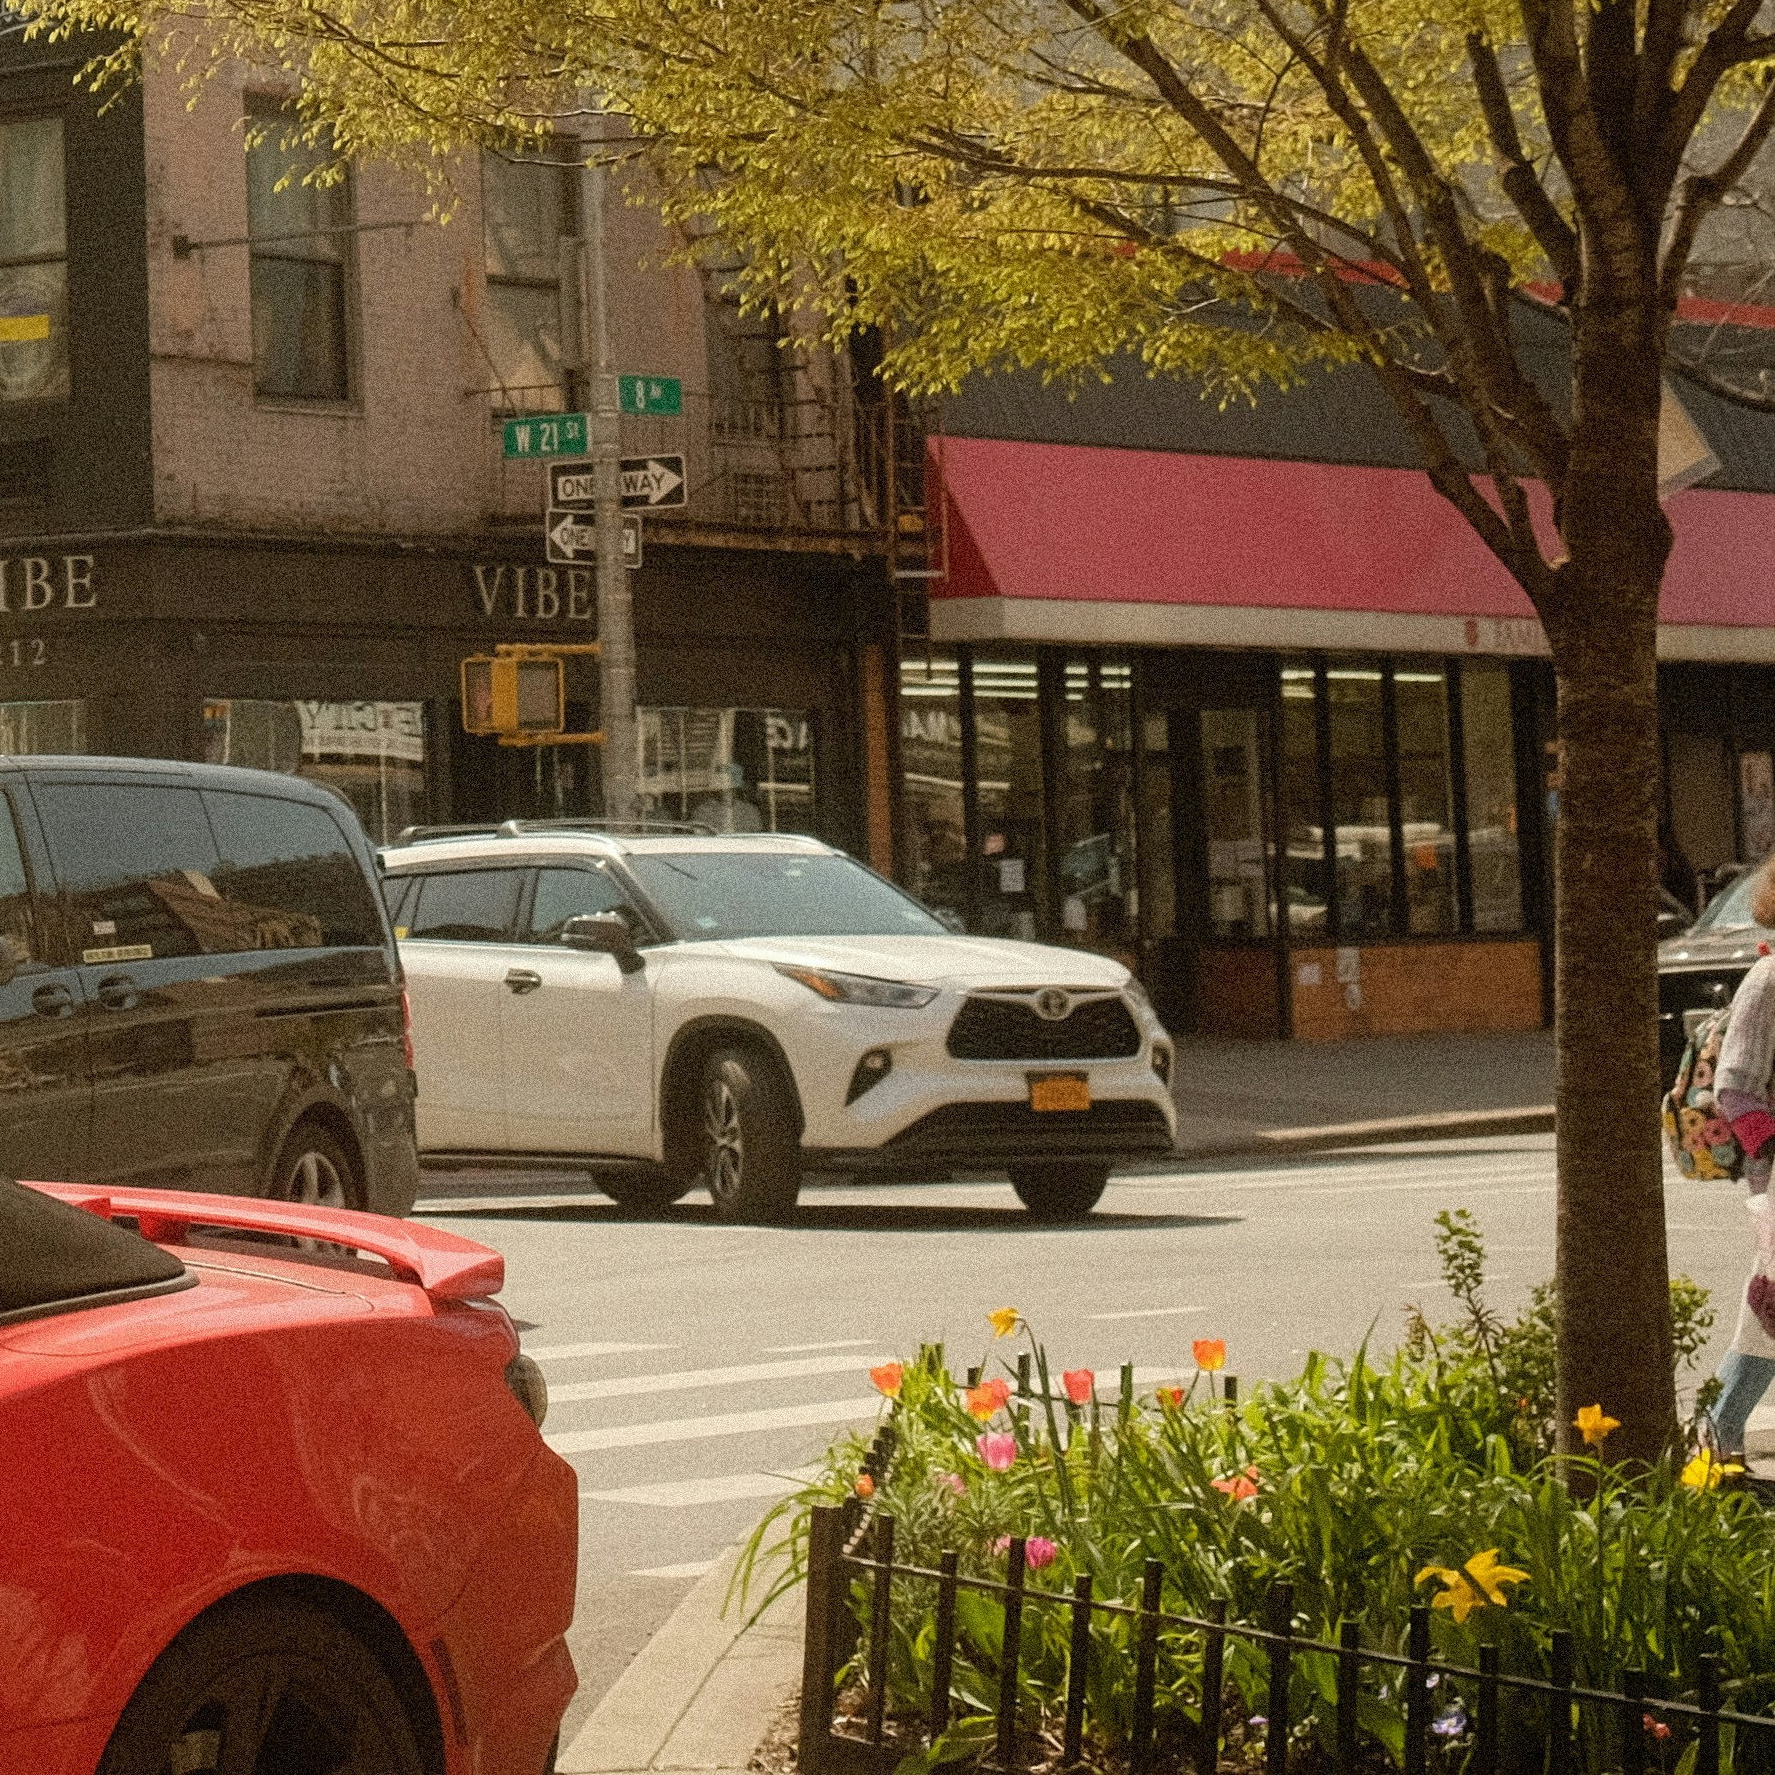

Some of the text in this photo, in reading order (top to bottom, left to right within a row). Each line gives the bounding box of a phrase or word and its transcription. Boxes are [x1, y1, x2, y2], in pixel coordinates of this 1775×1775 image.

[635, 381, 646, 409] 8
[515, 422, 579, 453] W 21 St
[624, 473, 664, 493] WAY
[560, 528, 588, 546] ONE
[473, 566, 593, 619] VIBE
